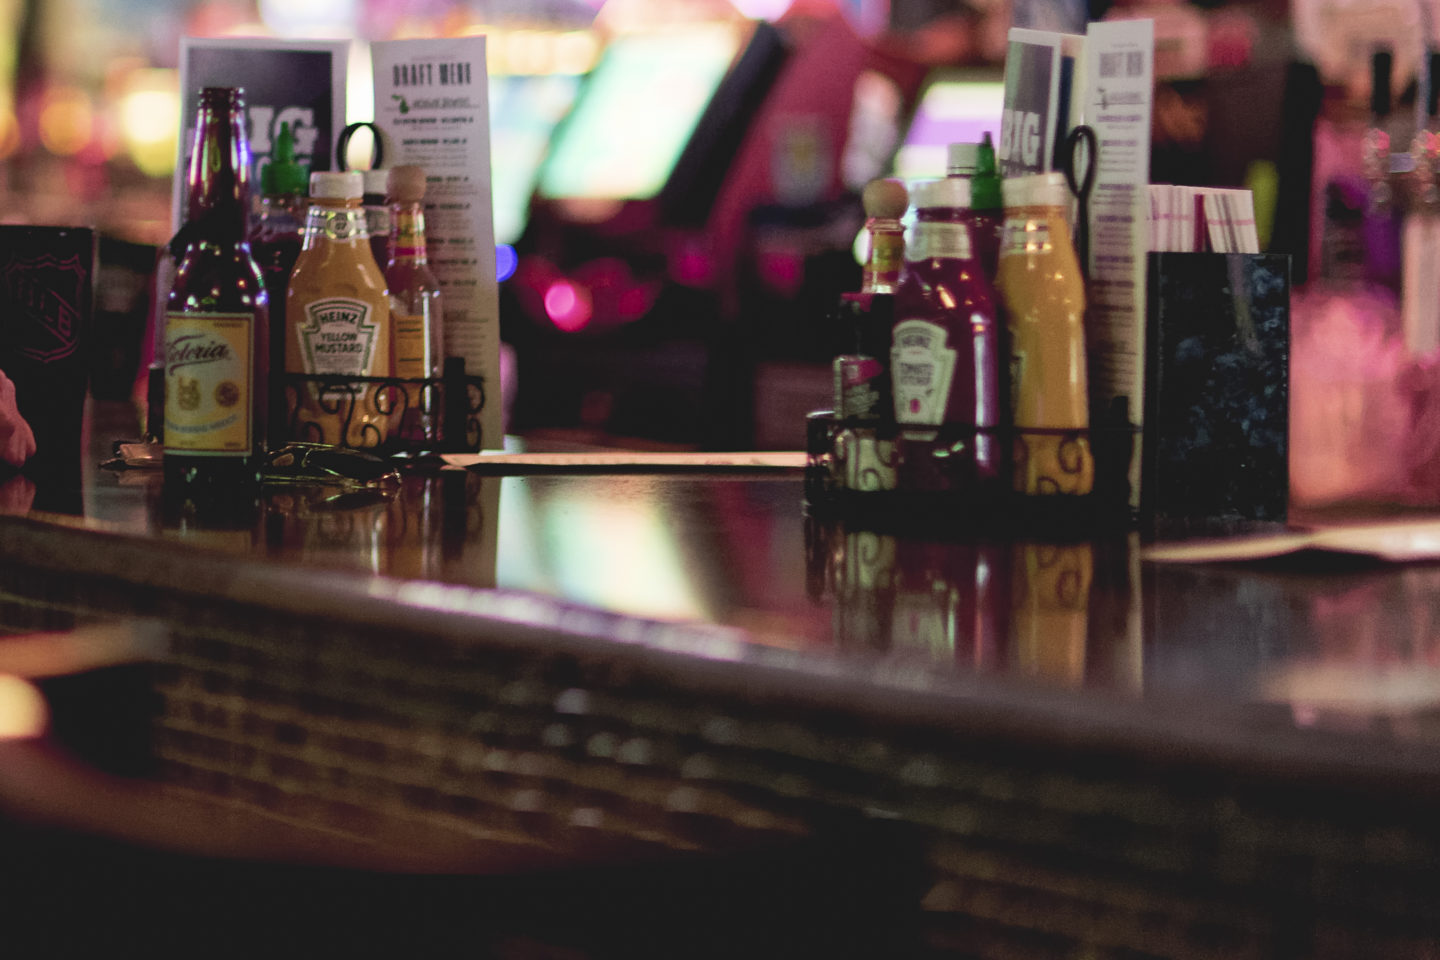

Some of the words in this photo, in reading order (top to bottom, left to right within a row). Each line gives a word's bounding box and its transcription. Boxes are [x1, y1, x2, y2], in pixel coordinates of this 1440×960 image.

[392, 63, 432, 86] DRAFT
[320, 312, 359, 325] HEINZ
[321, 332, 358, 342] YELLOW
[315, 342, 363, 355] MUSTARD
